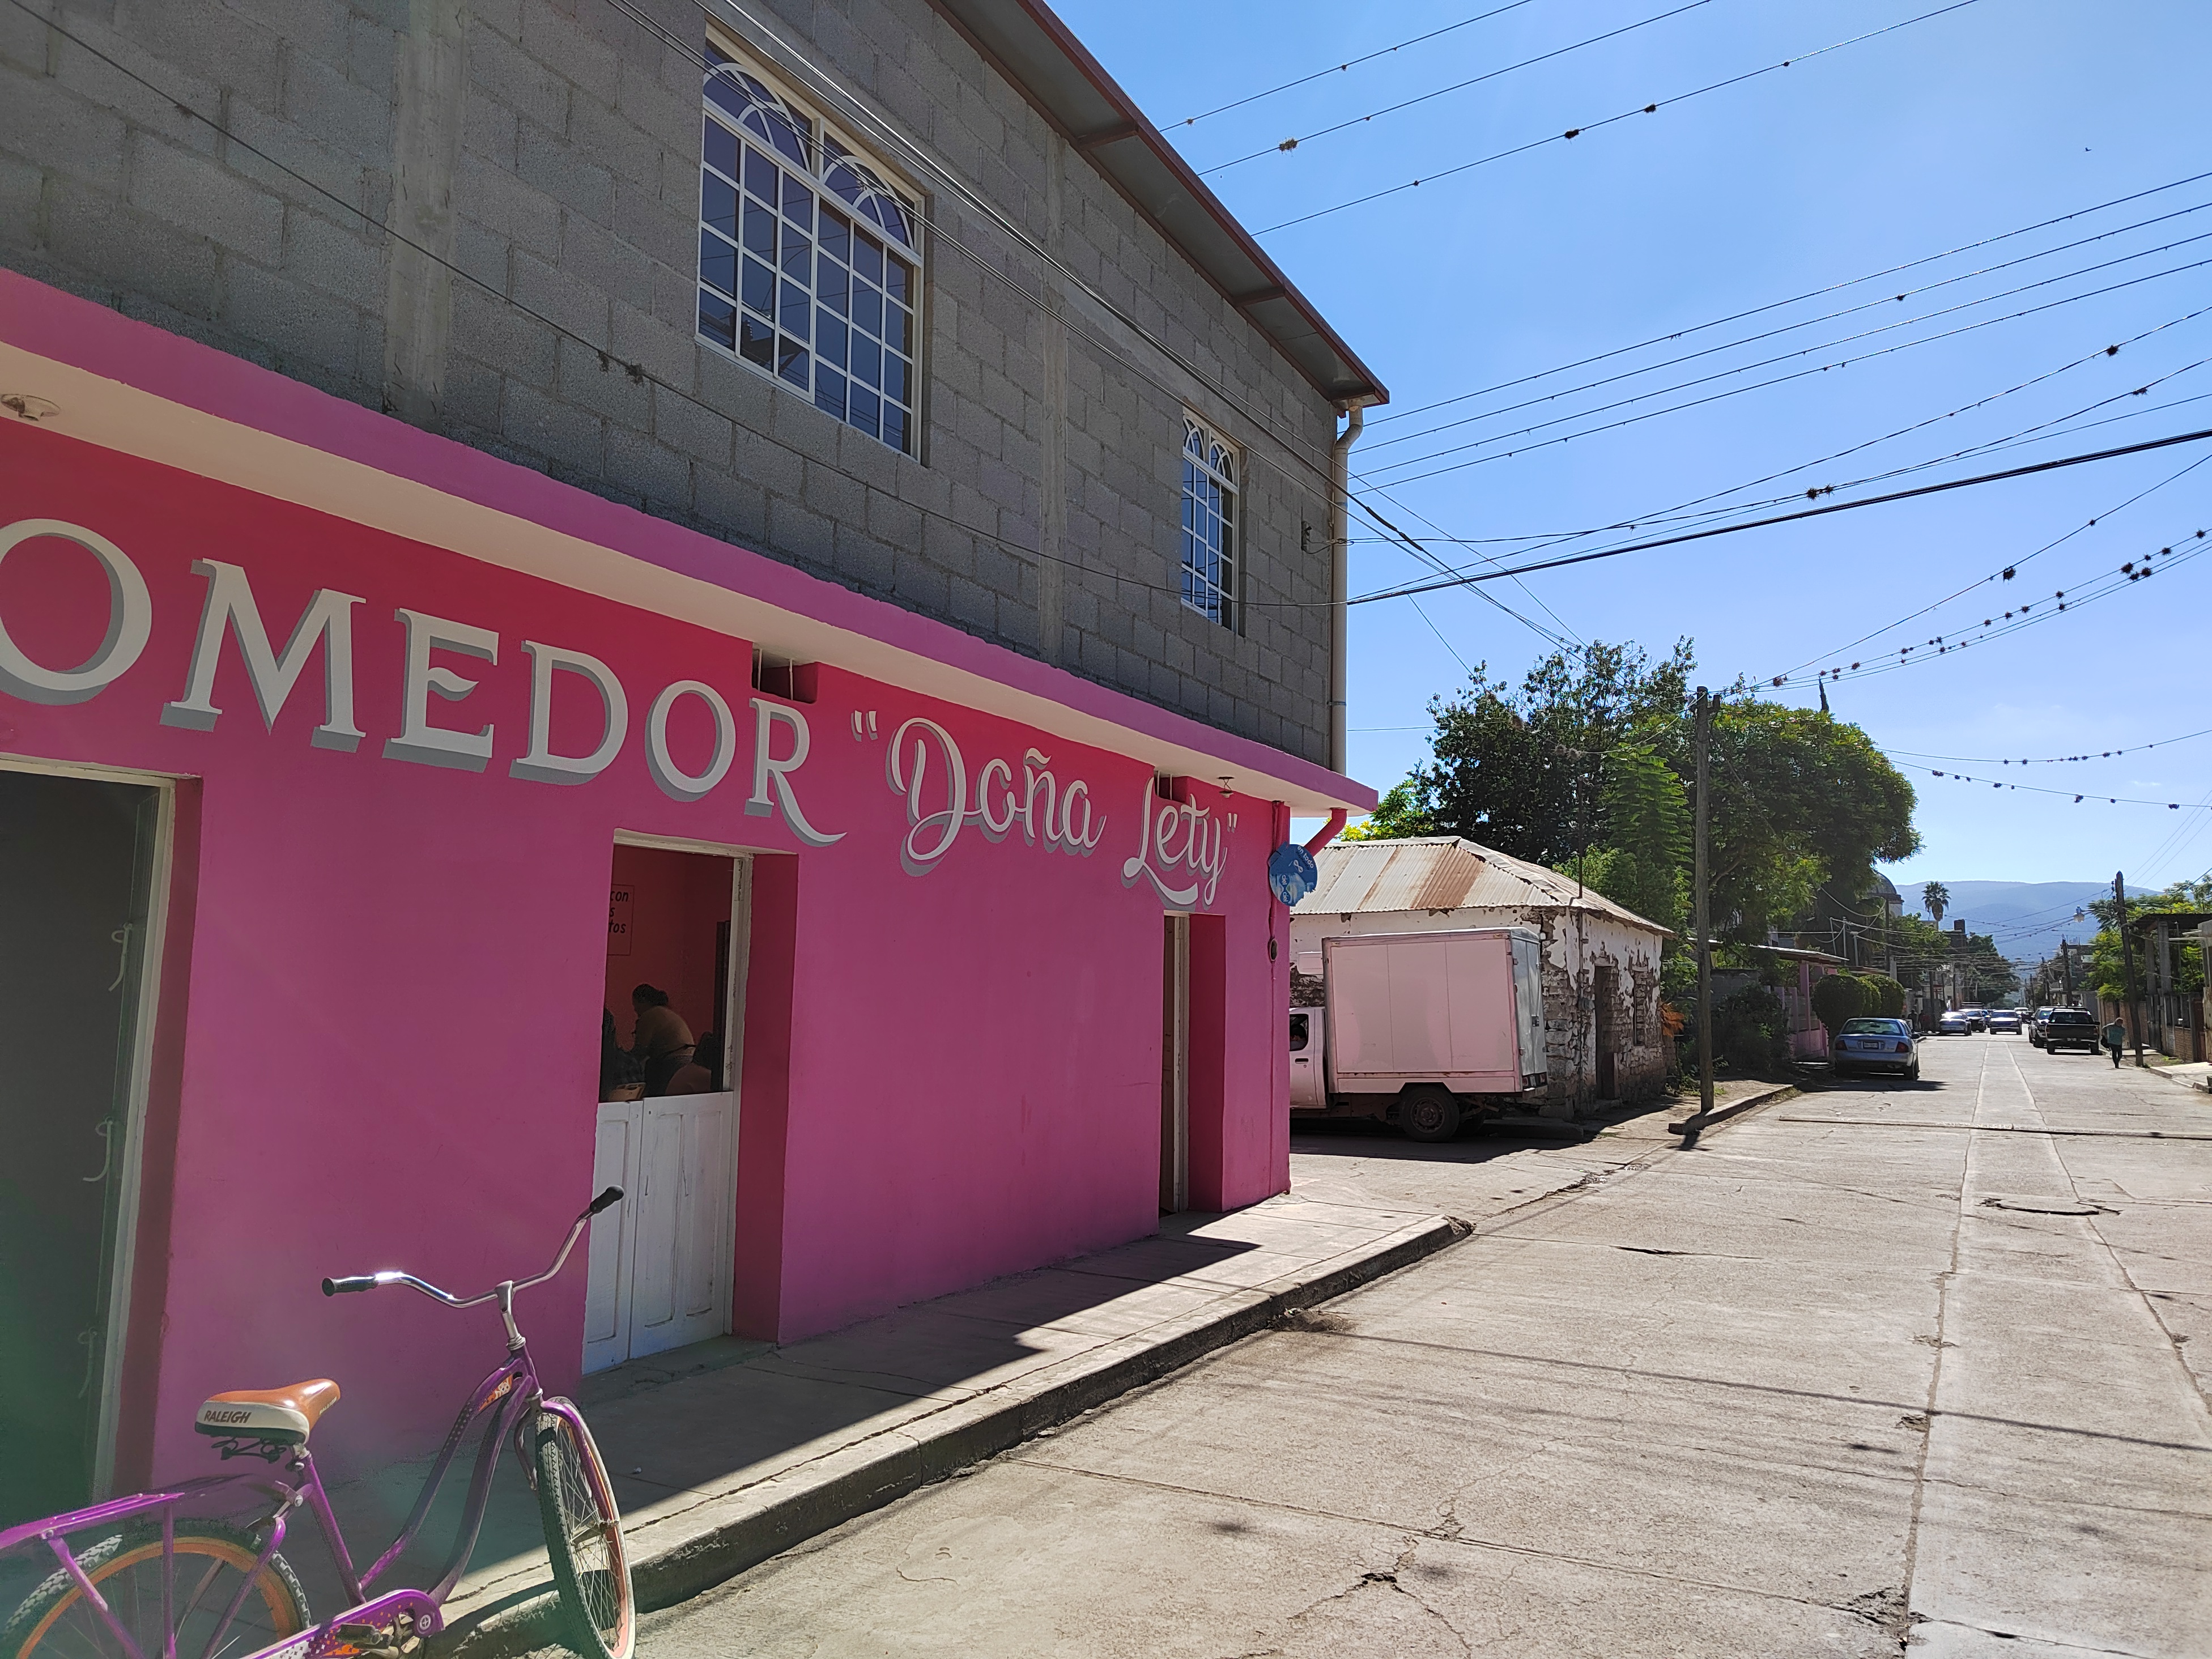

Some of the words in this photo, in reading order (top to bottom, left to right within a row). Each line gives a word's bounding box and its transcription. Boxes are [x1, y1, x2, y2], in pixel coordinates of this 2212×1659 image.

[851, 710, 1108, 867] "Doña
[1122, 776, 1238, 908] Lety"
[319, 1396, 337, 1415] RALEIGH
[203, 1410, 252, 1423] RALEIGH
